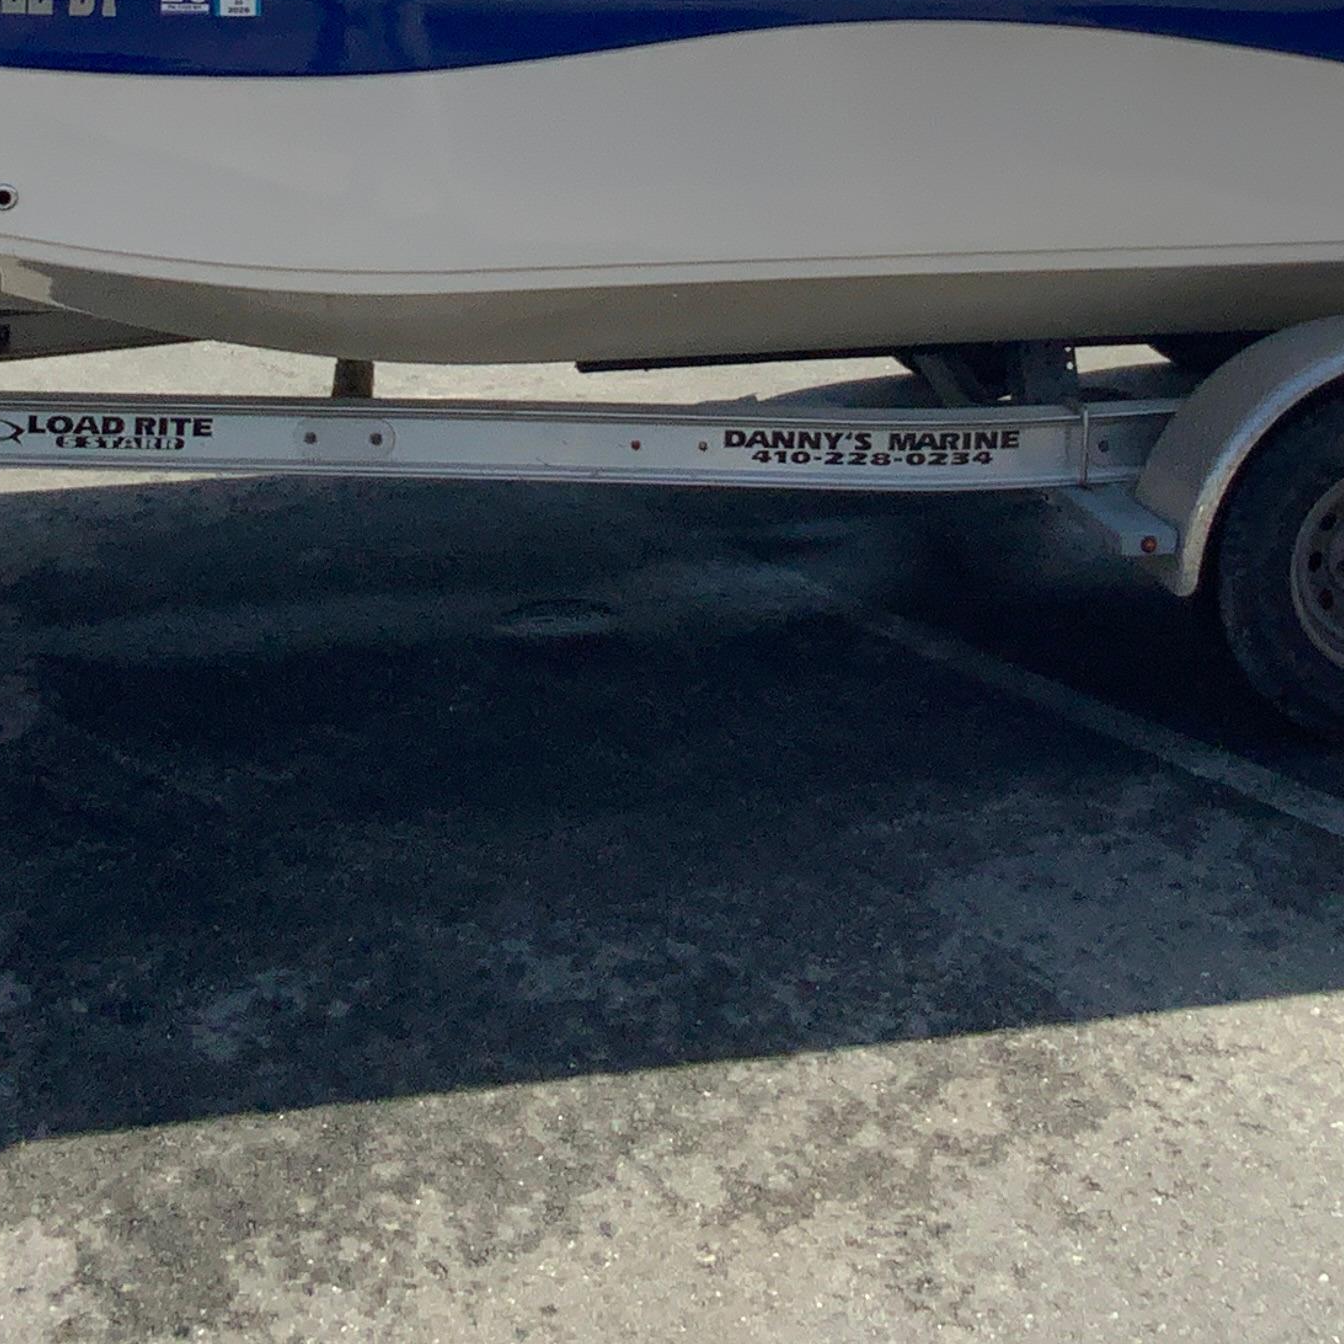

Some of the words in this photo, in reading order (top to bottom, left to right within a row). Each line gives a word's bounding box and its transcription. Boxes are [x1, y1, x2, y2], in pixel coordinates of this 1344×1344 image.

[28, 415, 124, 435] LOAD
[134, 416, 214, 438] RITE
[723, 430, 872, 450] DANNY'S
[888, 430, 1020, 451] MARINE
[752, 451, 994, 465] 410-228-0234
